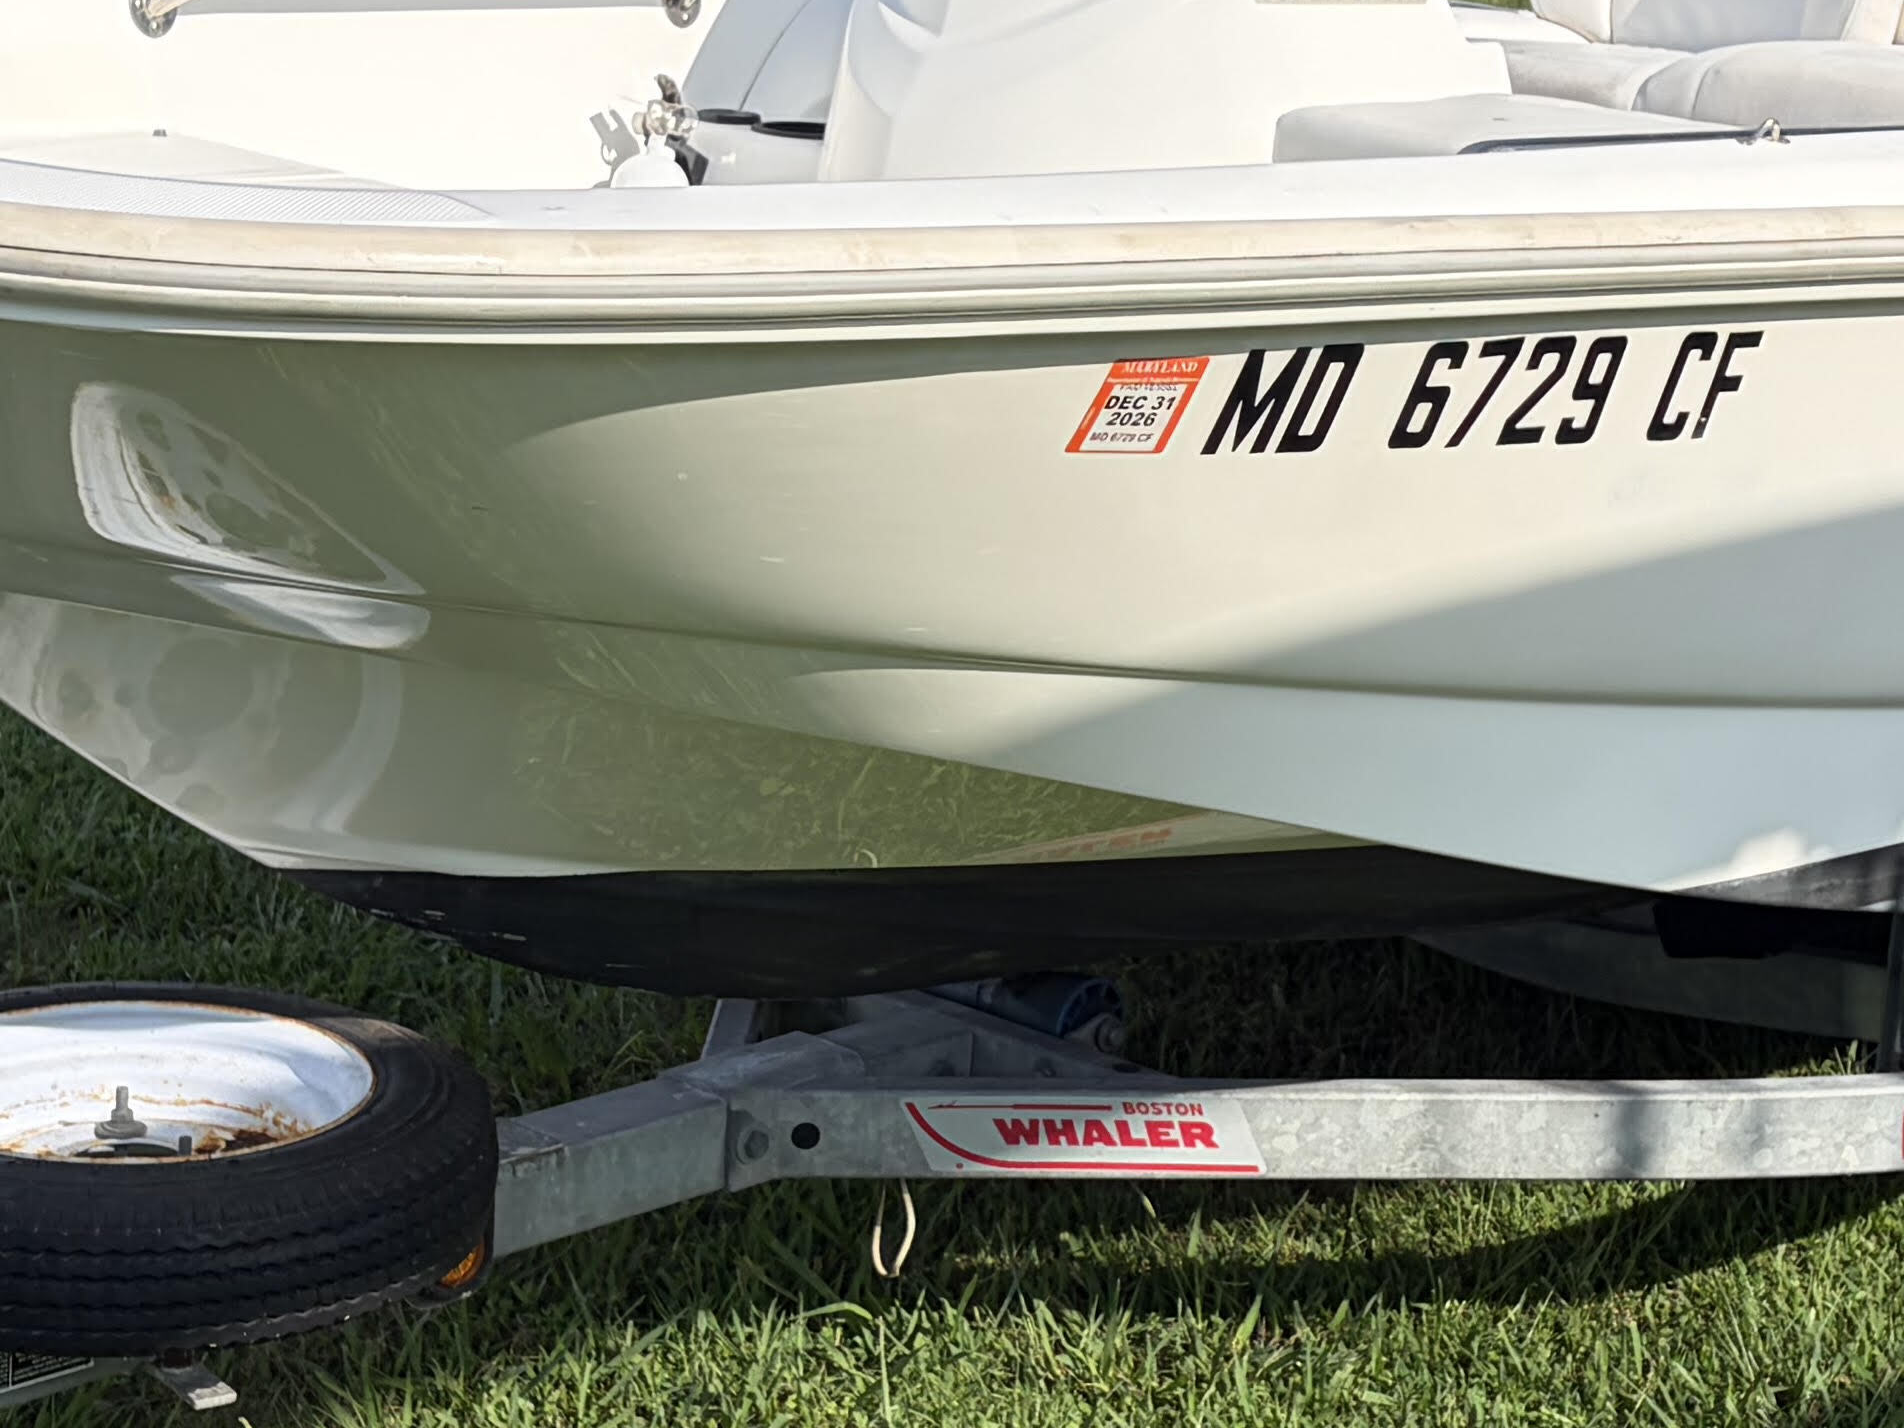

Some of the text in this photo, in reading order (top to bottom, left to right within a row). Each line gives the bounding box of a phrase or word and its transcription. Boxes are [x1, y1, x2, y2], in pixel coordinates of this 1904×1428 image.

[1122, 361, 1199, 374] MARYLAND
[1200, 330, 1763, 455] MD 6729 CF
[1104, 395, 1176, 410] DEC 31
[1106, 412, 1157, 427] 2026
[1122, 1101, 1204, 1117] BOSTON
[993, 1118, 1219, 1149] WHALER
